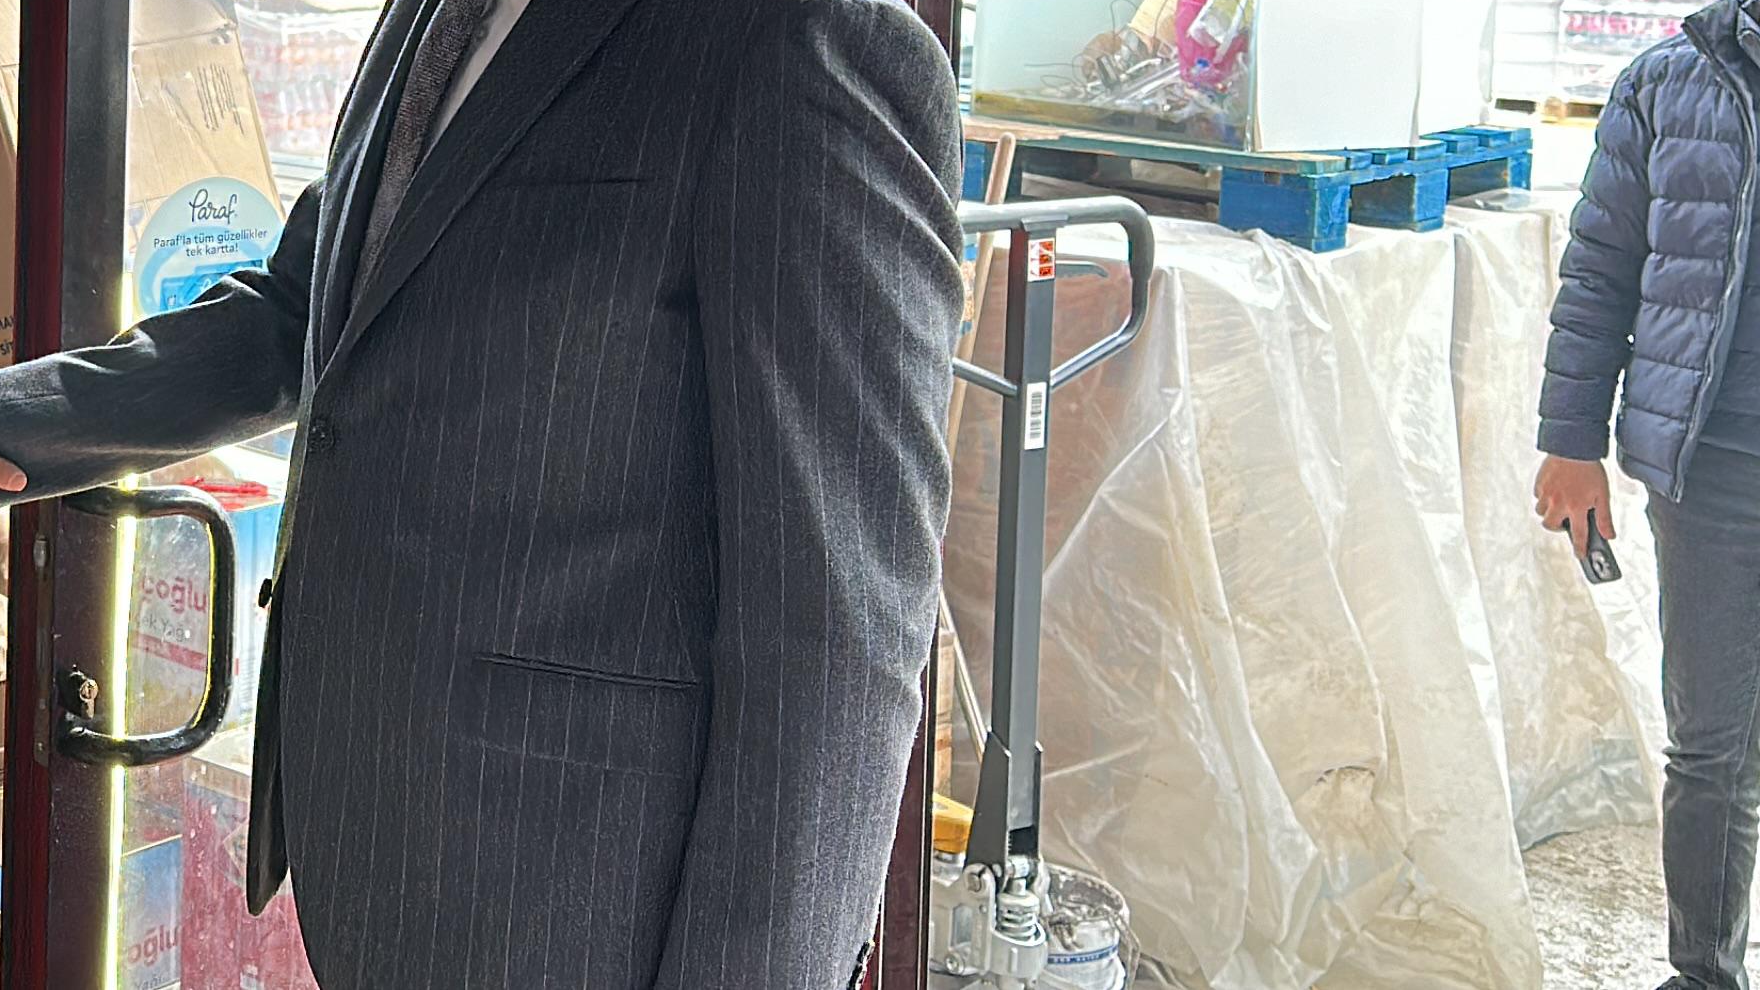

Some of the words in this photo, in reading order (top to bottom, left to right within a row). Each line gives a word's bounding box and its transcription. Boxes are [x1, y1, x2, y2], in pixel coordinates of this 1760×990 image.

[189, 188, 237, 224] Paraf
[154, 235, 191, 248] Paraf'la
[194, 233, 214, 245] tüm
[217, 228, 268, 245] güzellikler
[186, 248, 202, 257] tek
[205, 242, 239, 255] kartta!
